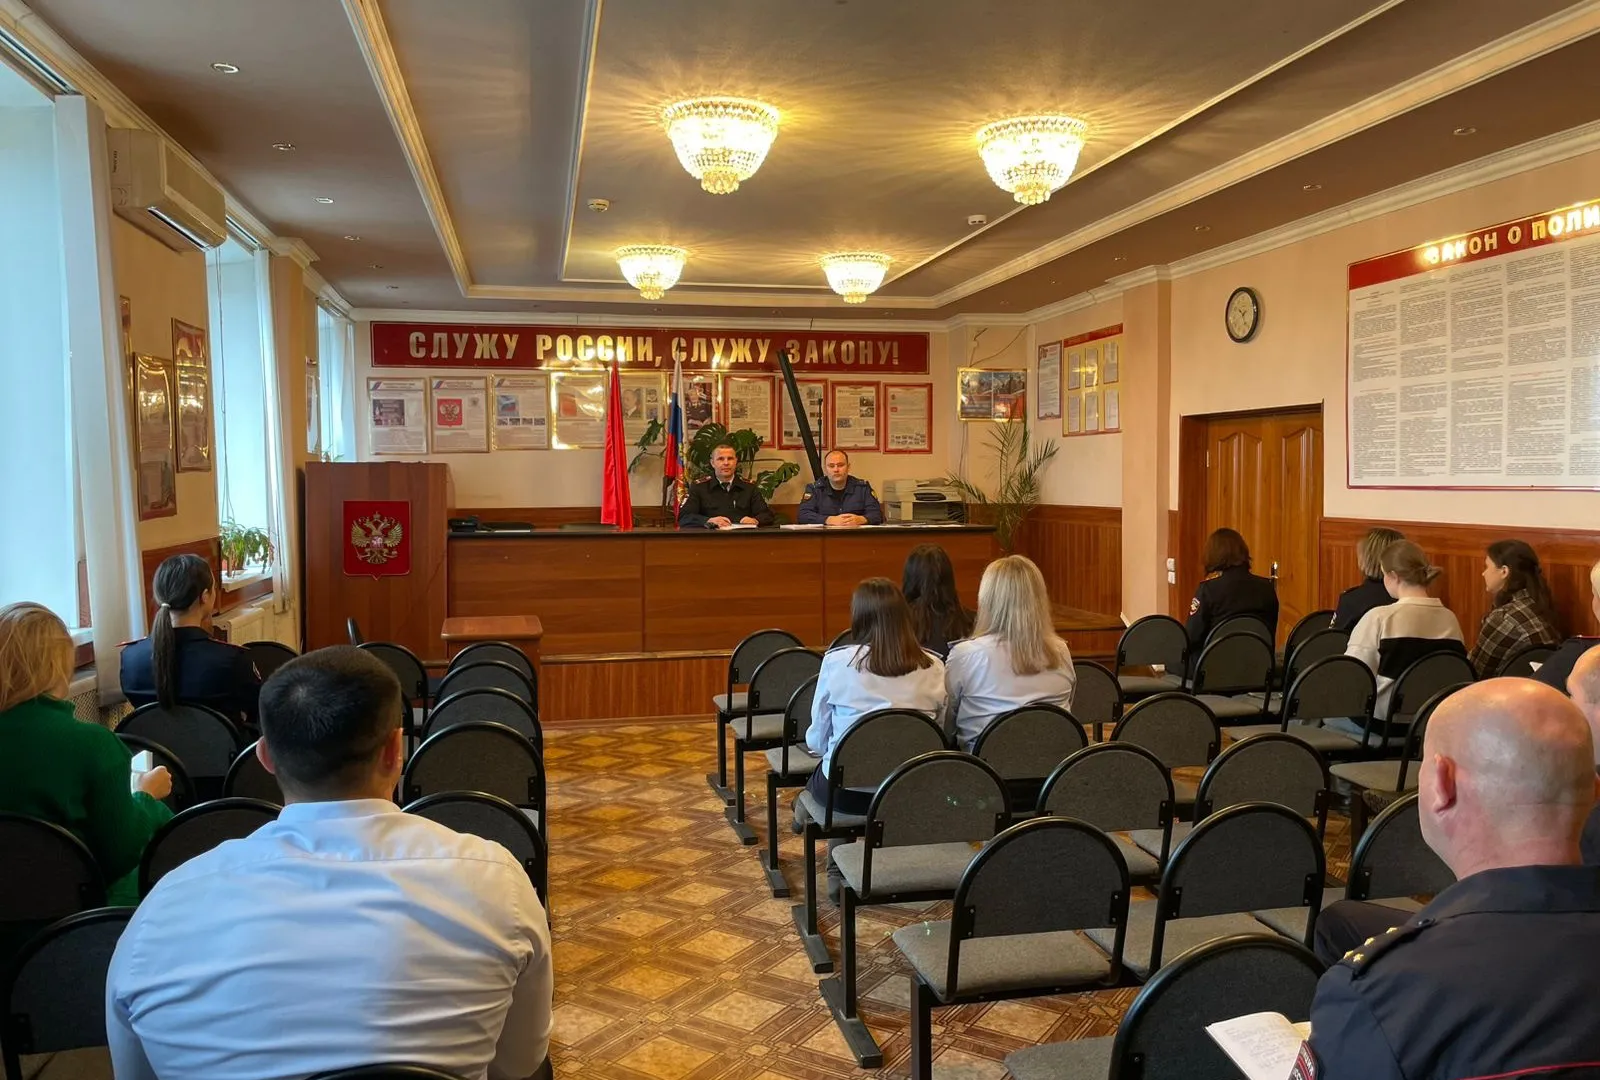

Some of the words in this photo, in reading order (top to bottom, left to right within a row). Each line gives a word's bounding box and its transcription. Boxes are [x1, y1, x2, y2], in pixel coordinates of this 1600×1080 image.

[1424, 231, 1498, 264] ЗАКОН
[1507, 226, 1522, 245] О
[408, 331, 520, 360] СЛУЖУ
[535, 334, 662, 368] РОССИИ,
[671, 336, 771, 364] СЛУЖУ
[785, 339, 900, 366] ЗАКОНУ!
